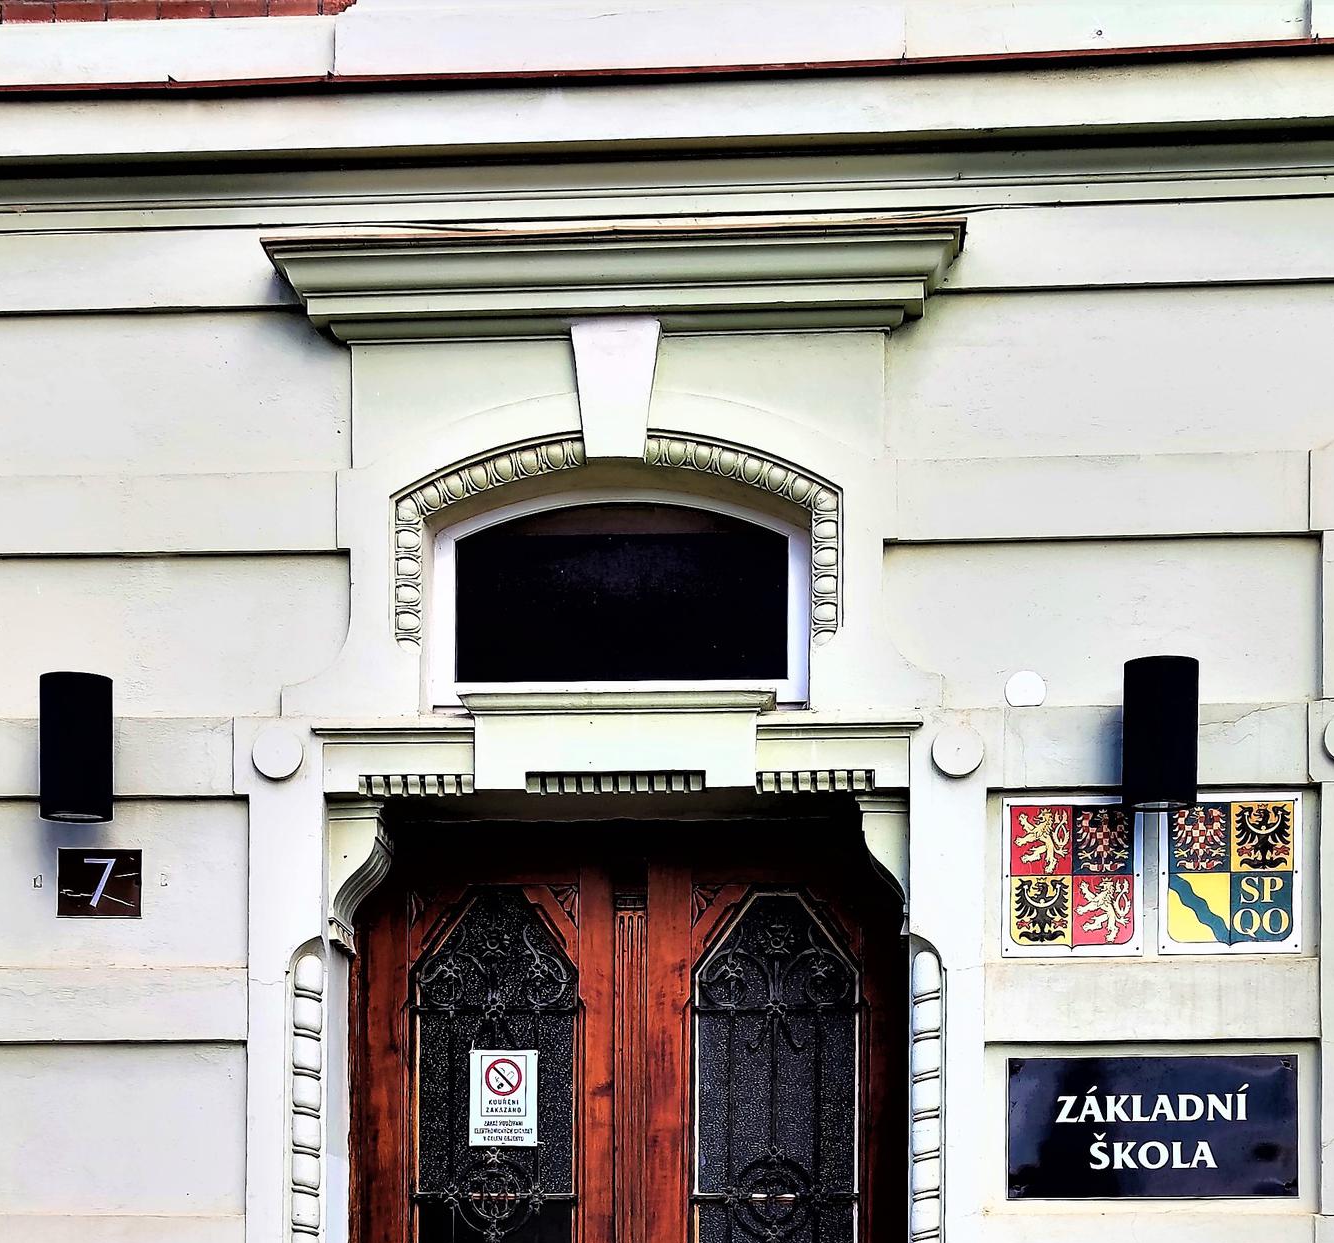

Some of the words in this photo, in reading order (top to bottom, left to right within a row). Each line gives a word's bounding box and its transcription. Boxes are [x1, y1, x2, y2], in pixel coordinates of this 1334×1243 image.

[83, 858, 117, 907] 7
[1240, 876, 1284, 904] SP
[1233, 907, 1290, 938] QO
[1055, 1083, 1249, 1123] ZÁKLADNÍ
[1089, 1132, 1218, 1170] ŠKOLA
